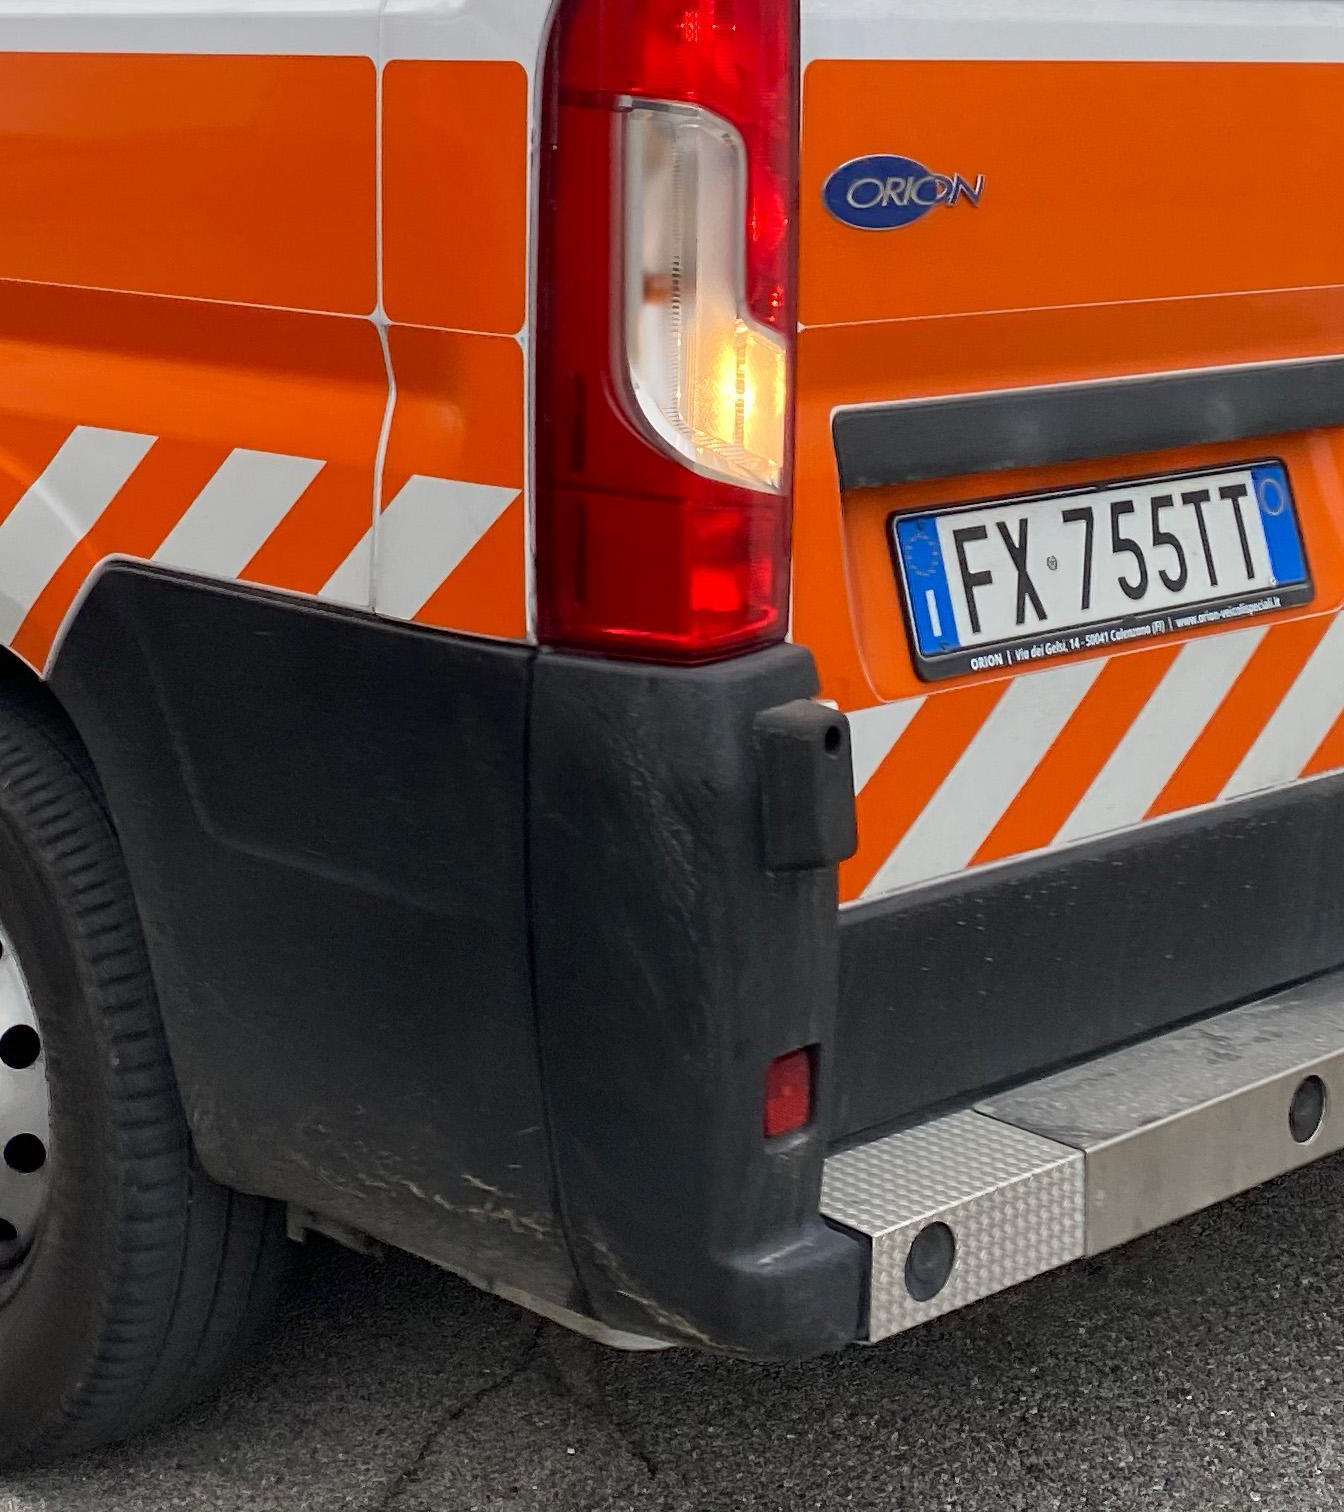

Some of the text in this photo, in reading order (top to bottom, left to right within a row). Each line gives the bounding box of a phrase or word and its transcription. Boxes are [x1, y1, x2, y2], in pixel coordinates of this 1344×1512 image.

[847, 172, 986, 209] ORION
[953, 483, 1256, 634] FX 755TT
[970, 652, 1004, 672] ORION
[1015, 647, 1030, 661] Via
[1069, 636, 1080, 650] 14
